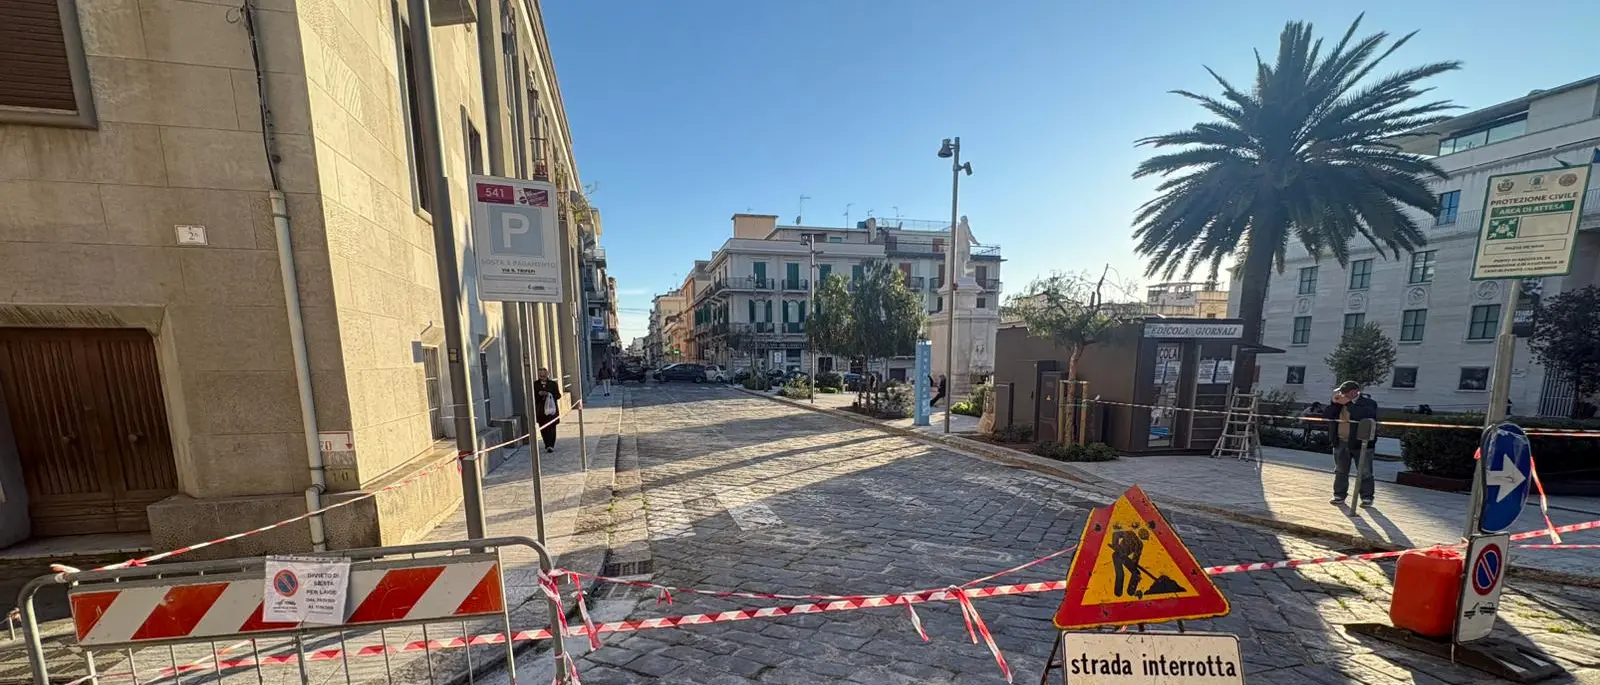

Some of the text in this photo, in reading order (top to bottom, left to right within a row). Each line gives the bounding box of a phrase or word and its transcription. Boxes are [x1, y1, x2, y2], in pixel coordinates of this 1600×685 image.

[485, 187, 505, 198] 541
[1490, 191, 1579, 206] PROTEZIONE CIVILE
[1499, 203, 1565, 215] AREA DI ATTESA
[502, 212, 530, 248] P
[513, 260, 556, 269] PAGAMENTO
[1151, 327, 1238, 336] EDICOLA GIORNALI
[1071, 653, 1237, 677] strada interrotta
